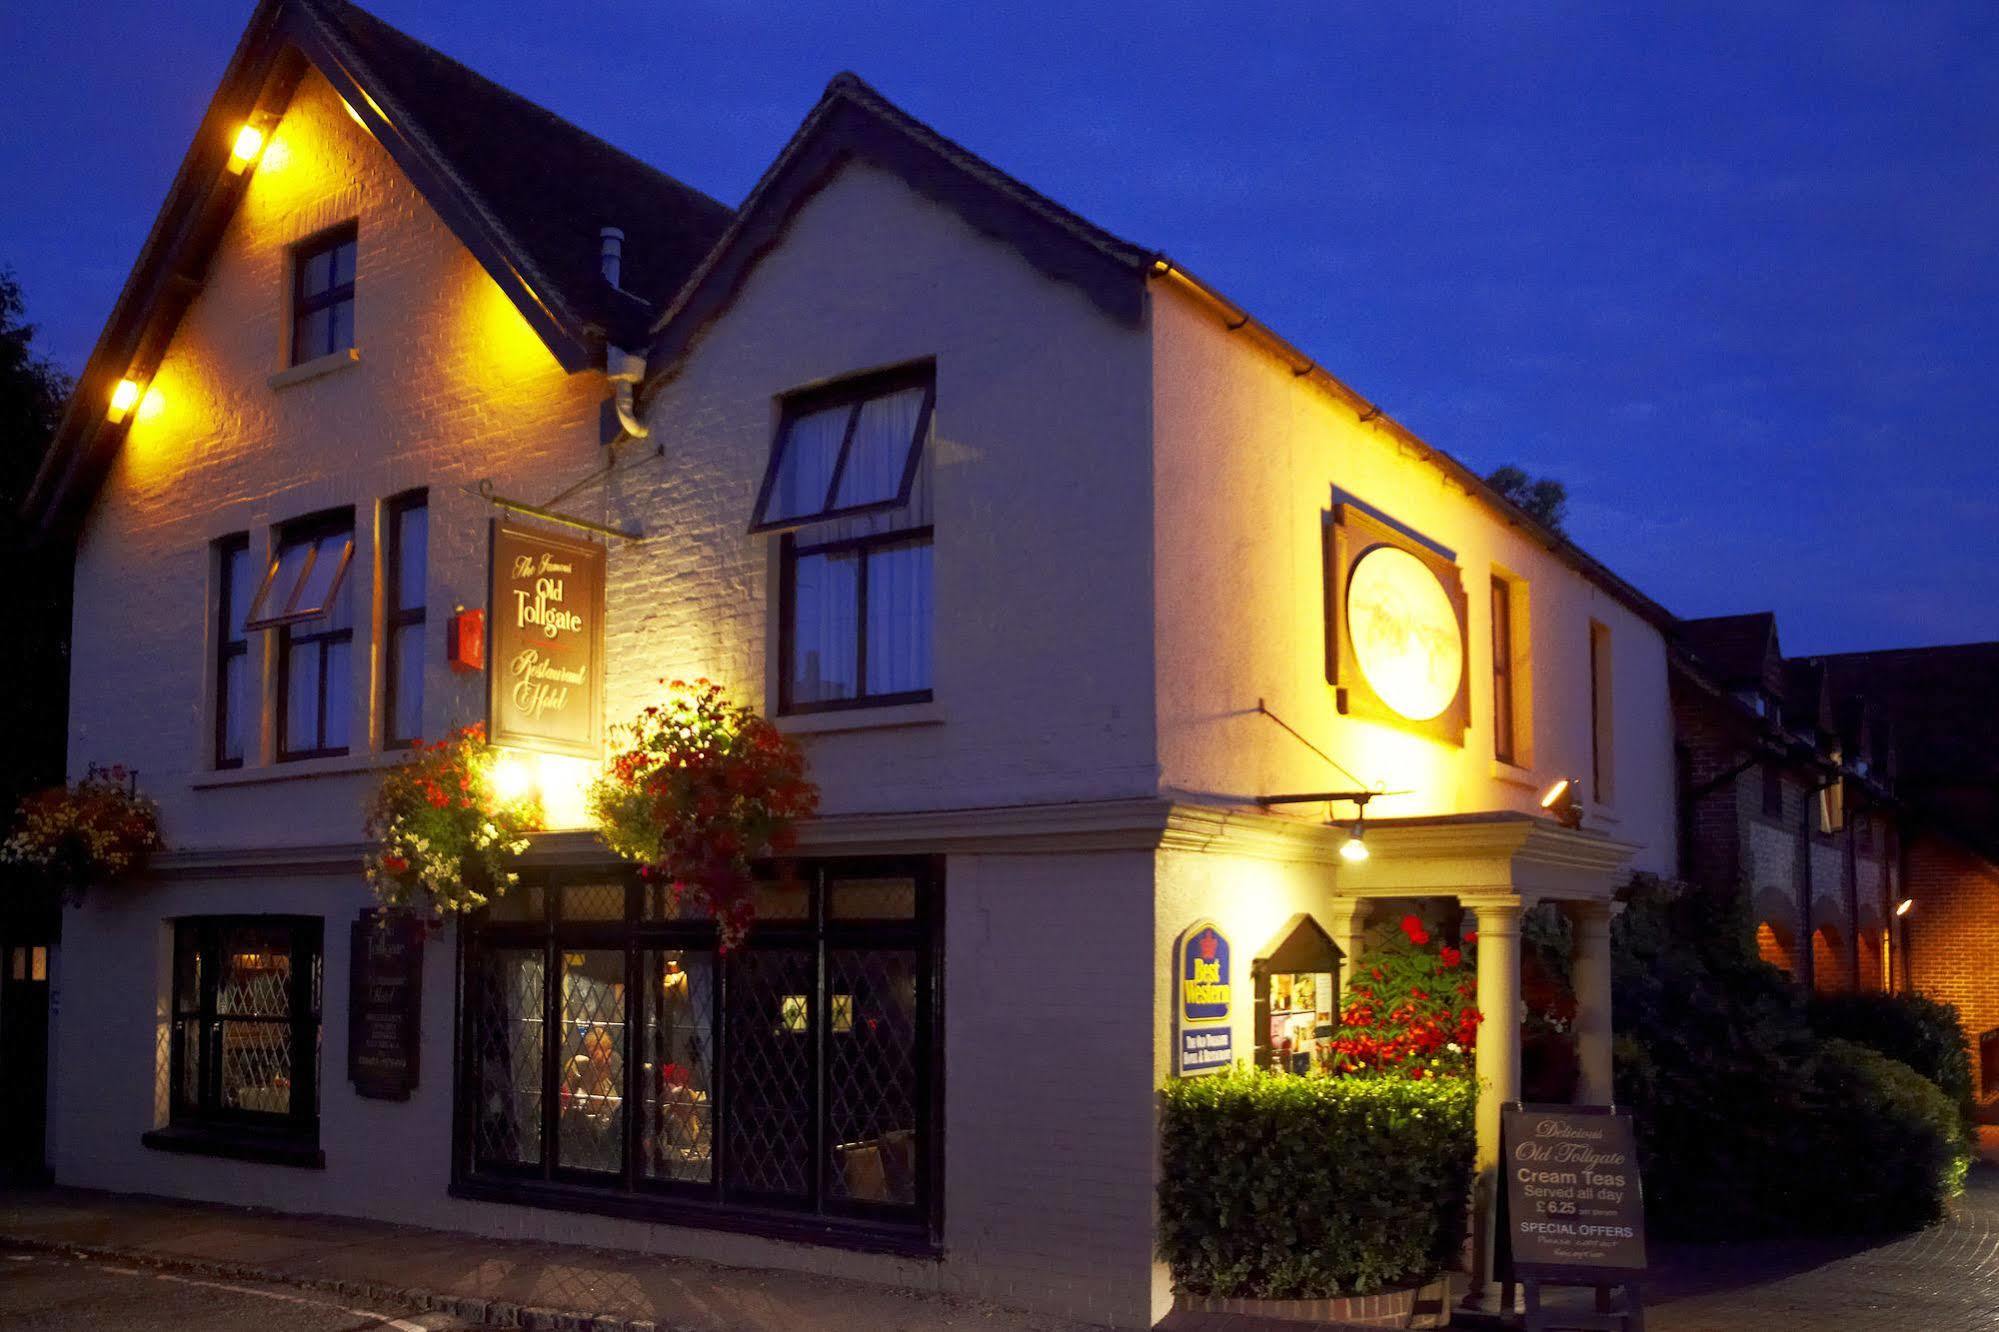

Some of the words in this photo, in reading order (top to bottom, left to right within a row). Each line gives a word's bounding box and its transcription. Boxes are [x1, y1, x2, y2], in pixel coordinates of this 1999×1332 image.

[536, 577, 563, 602] Old
[513, 589, 582, 638] Tollgate
[512, 649, 587, 686] Restaurant
[1194, 958, 1220, 984] Best
[1184, 979, 1230, 1005] Western
[1535, 1120, 1603, 1139] Delicious
[1515, 1141, 1553, 1161] Old
[1554, 1142, 1625, 1170] Tollgate
[1517, 1168, 1577, 1184] Cream
[1581, 1171, 1626, 1187] Teas
[1524, 1184, 1574, 1199] Served
[1577, 1187, 1594, 1200] all
[1597, 1188, 1623, 1204] day
[1520, 1221, 1577, 1236] SPECIAL
[1579, 1224, 1634, 1239] OFFERS
